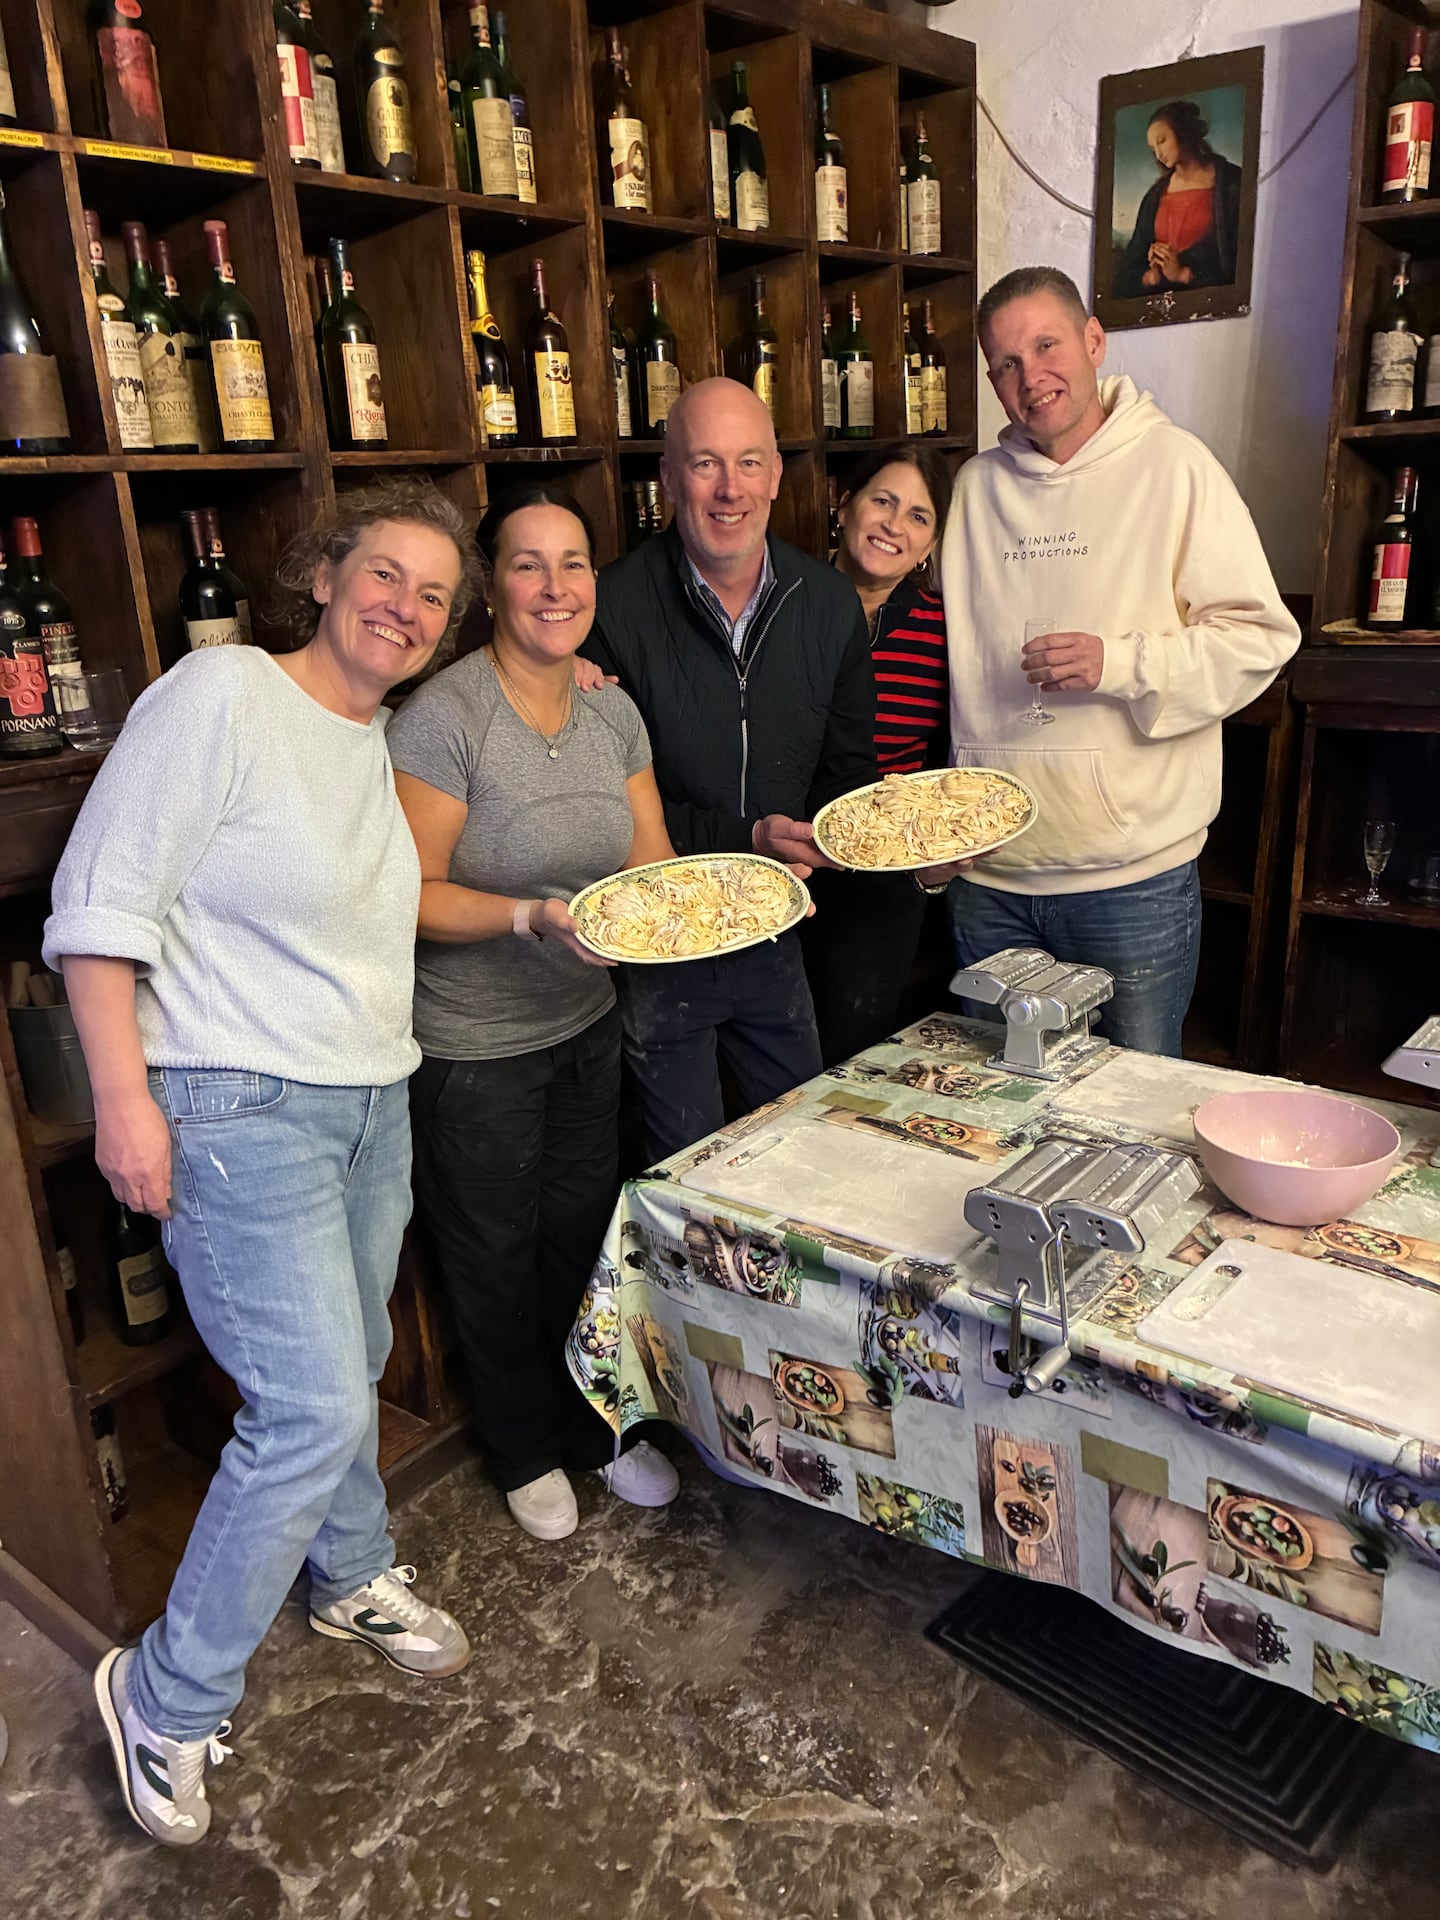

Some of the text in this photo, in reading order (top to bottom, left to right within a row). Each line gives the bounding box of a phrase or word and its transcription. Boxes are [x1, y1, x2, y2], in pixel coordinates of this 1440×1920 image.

[1018, 531, 1077, 546] WINNING
[1003, 545, 1089, 562] PRODUCTIONS
[1, 716, 57, 733] PORNANO
